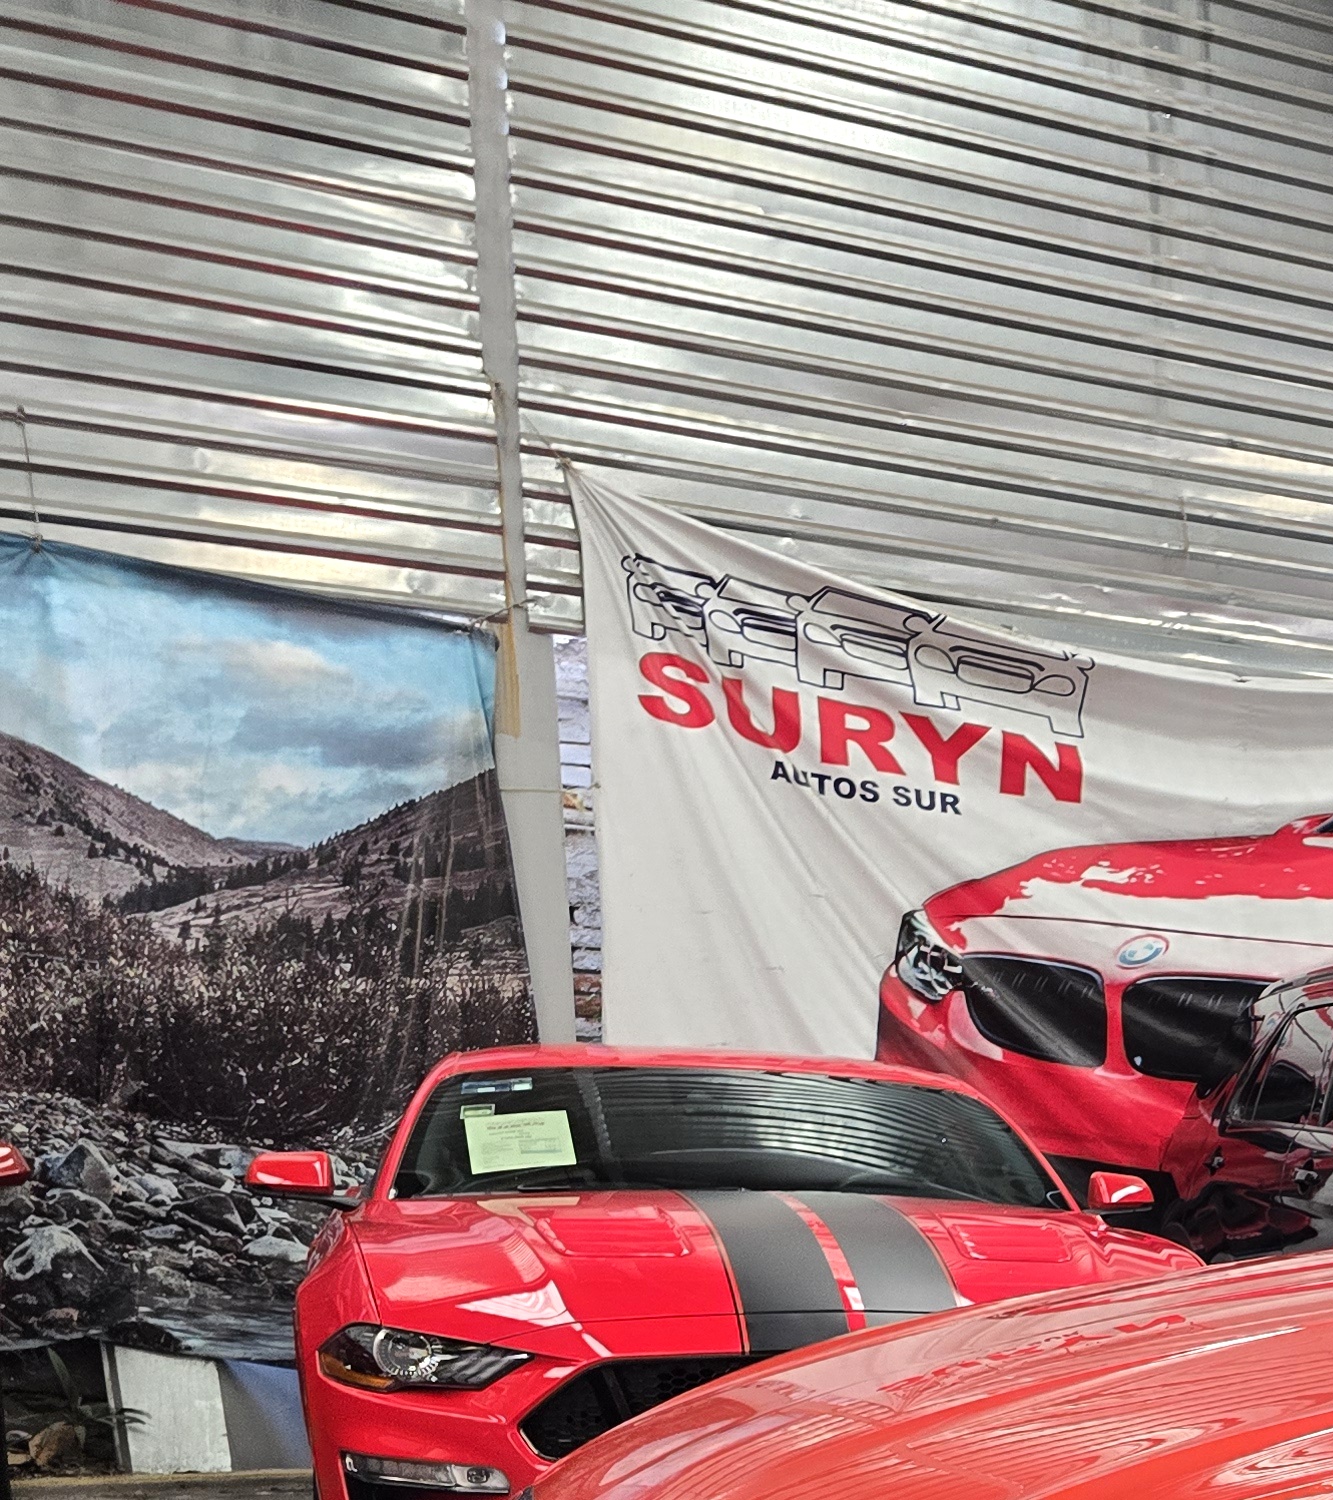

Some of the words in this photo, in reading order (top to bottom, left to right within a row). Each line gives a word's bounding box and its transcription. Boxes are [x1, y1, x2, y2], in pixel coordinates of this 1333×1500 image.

[638, 651, 1083, 804] SURYN
[770, 760, 881, 803] AUTOS
[892, 785, 962, 815] SUR
